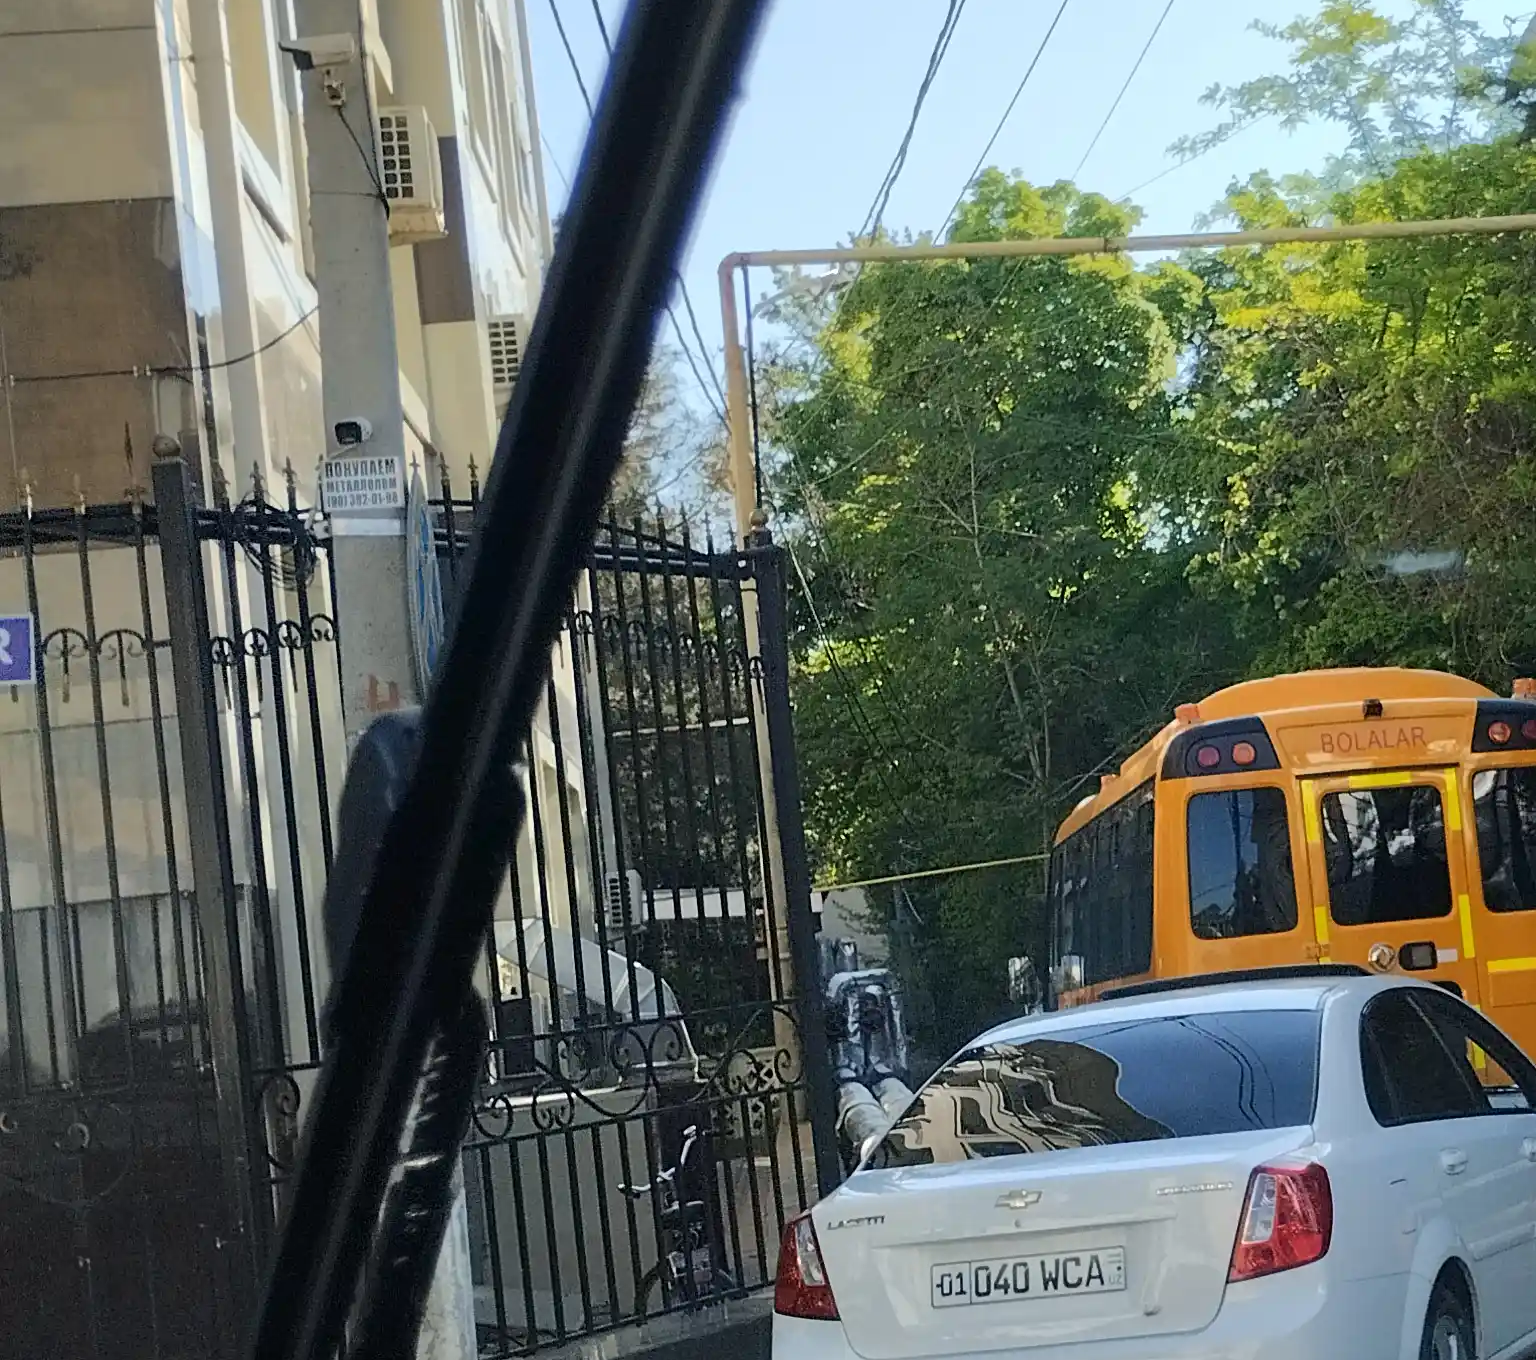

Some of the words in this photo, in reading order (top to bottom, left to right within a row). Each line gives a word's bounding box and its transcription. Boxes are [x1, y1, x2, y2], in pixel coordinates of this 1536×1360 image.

[1320, 726, 1428, 754] BOLALAR
[938, 1272, 967, 1297] 01
[974, 1261, 1030, 1298] 040
[1040, 1254, 1105, 1292] WCA
